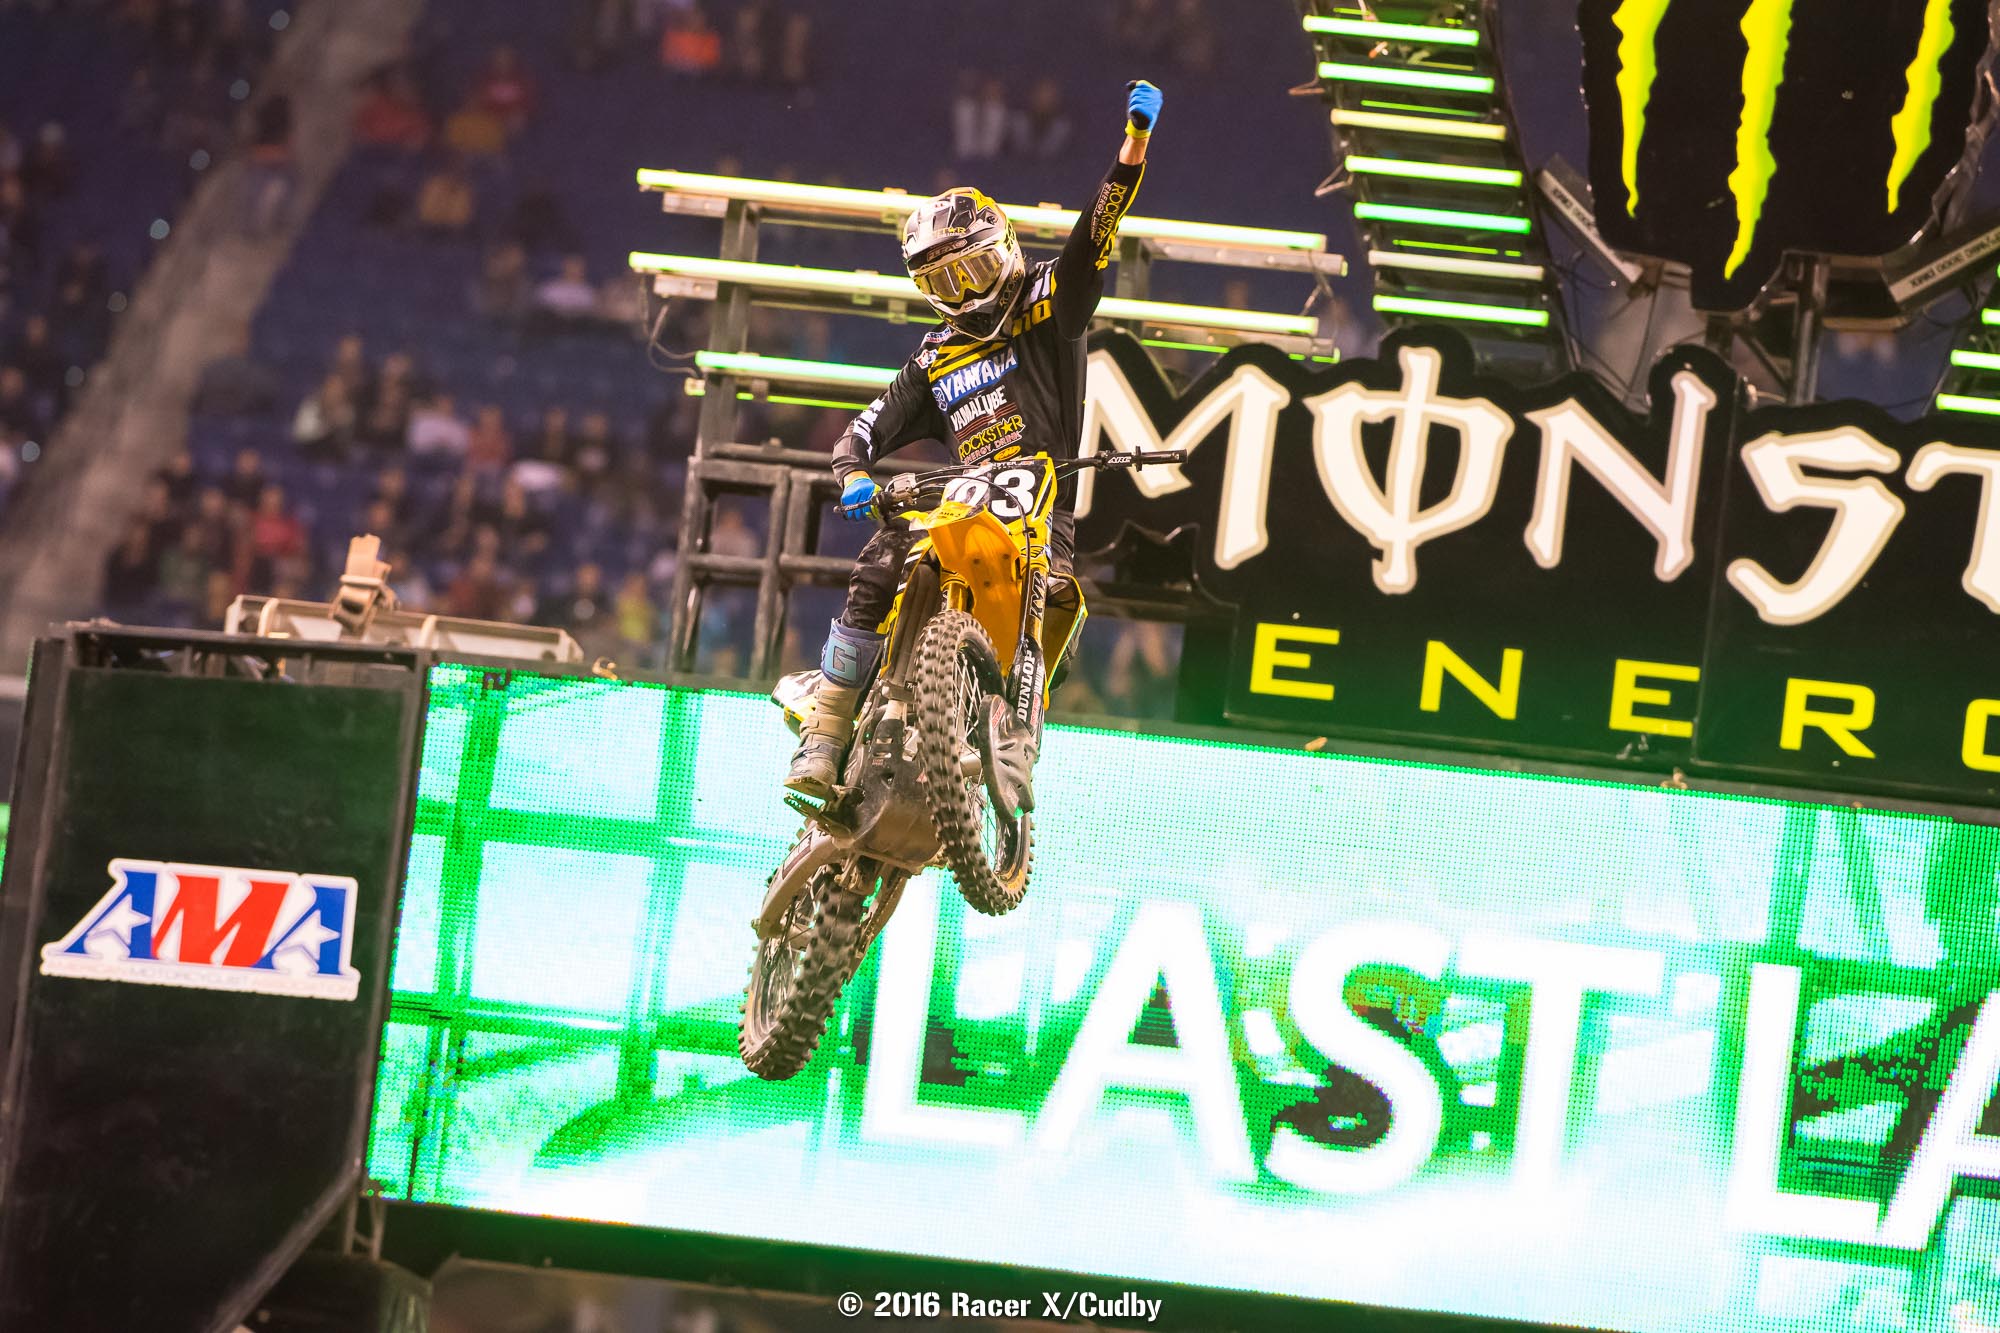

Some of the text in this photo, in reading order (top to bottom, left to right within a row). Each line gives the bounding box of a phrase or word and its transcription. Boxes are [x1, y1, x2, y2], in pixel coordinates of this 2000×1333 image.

[940, 347, 1017, 402] YAMAHA
[950, 385, 1008, 431] YAMALUBE
[1016, 649, 1036, 722] DUNLOP
[63, 869, 348, 977] AMA
[861, 867, 1667, 1200] LAST
